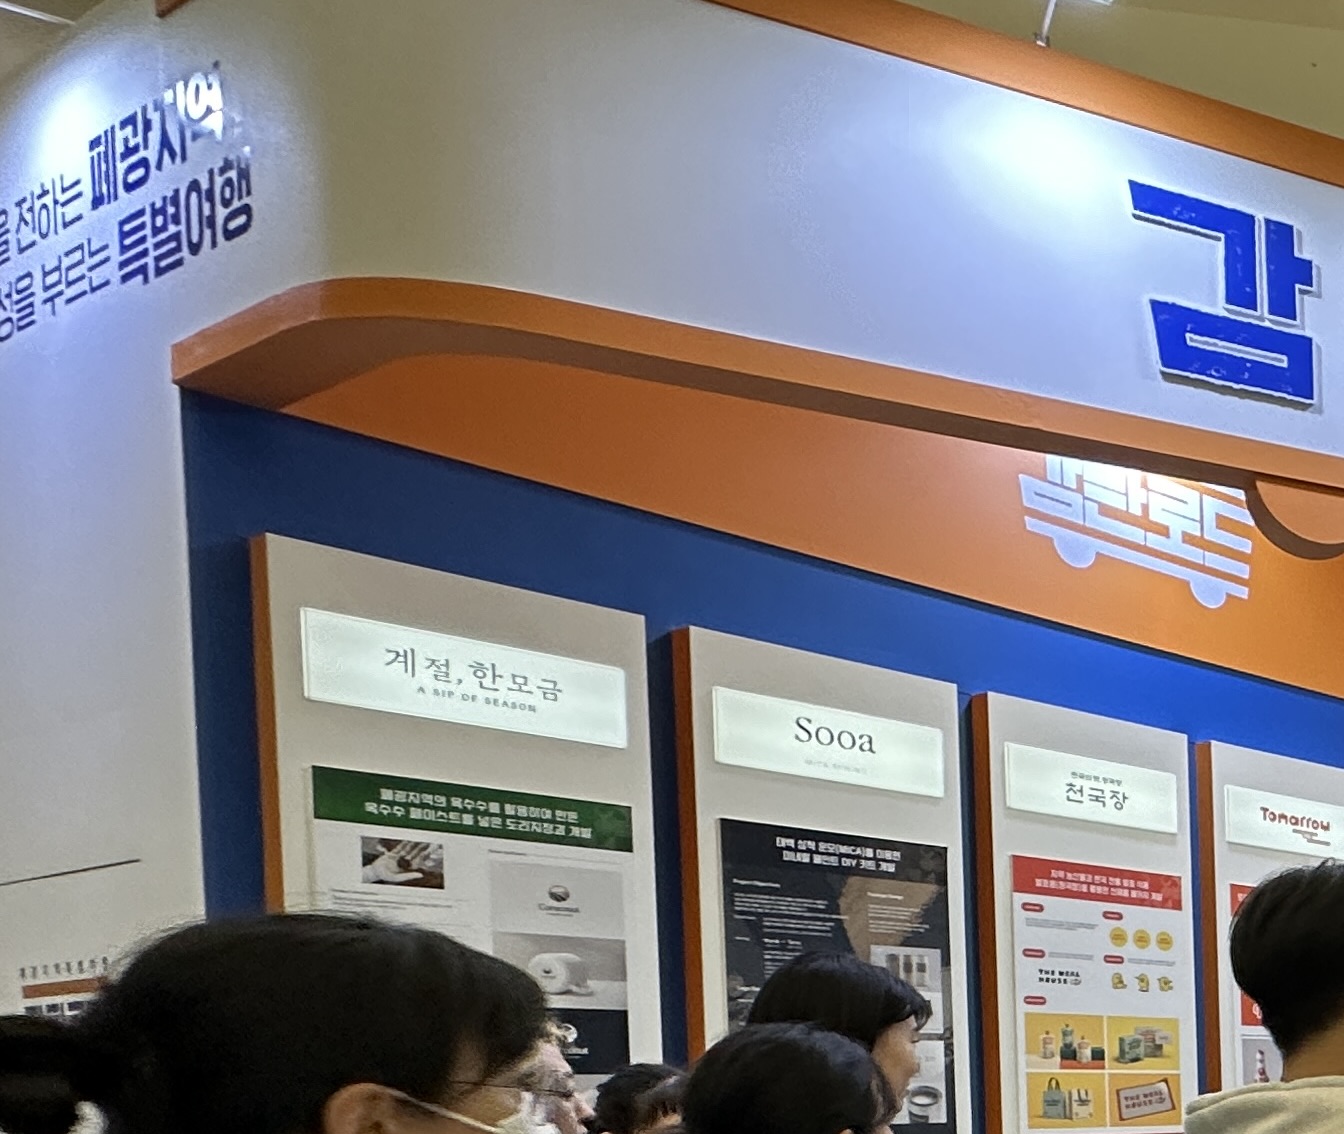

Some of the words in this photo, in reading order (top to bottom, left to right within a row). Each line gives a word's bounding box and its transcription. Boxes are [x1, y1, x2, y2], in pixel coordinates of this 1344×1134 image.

[15, 173, 84, 256] 전하는
[41, 237, 112, 317] 부르는
[117, 154, 253, 287] 특별여행
[417, 685, 425, 694] A
[484, 697, 537, 713] SEASON
[794, 716, 876, 755] Sooa
[1065, 782, 1129, 811] 천국장
[841, 857, 857, 868] DIY
